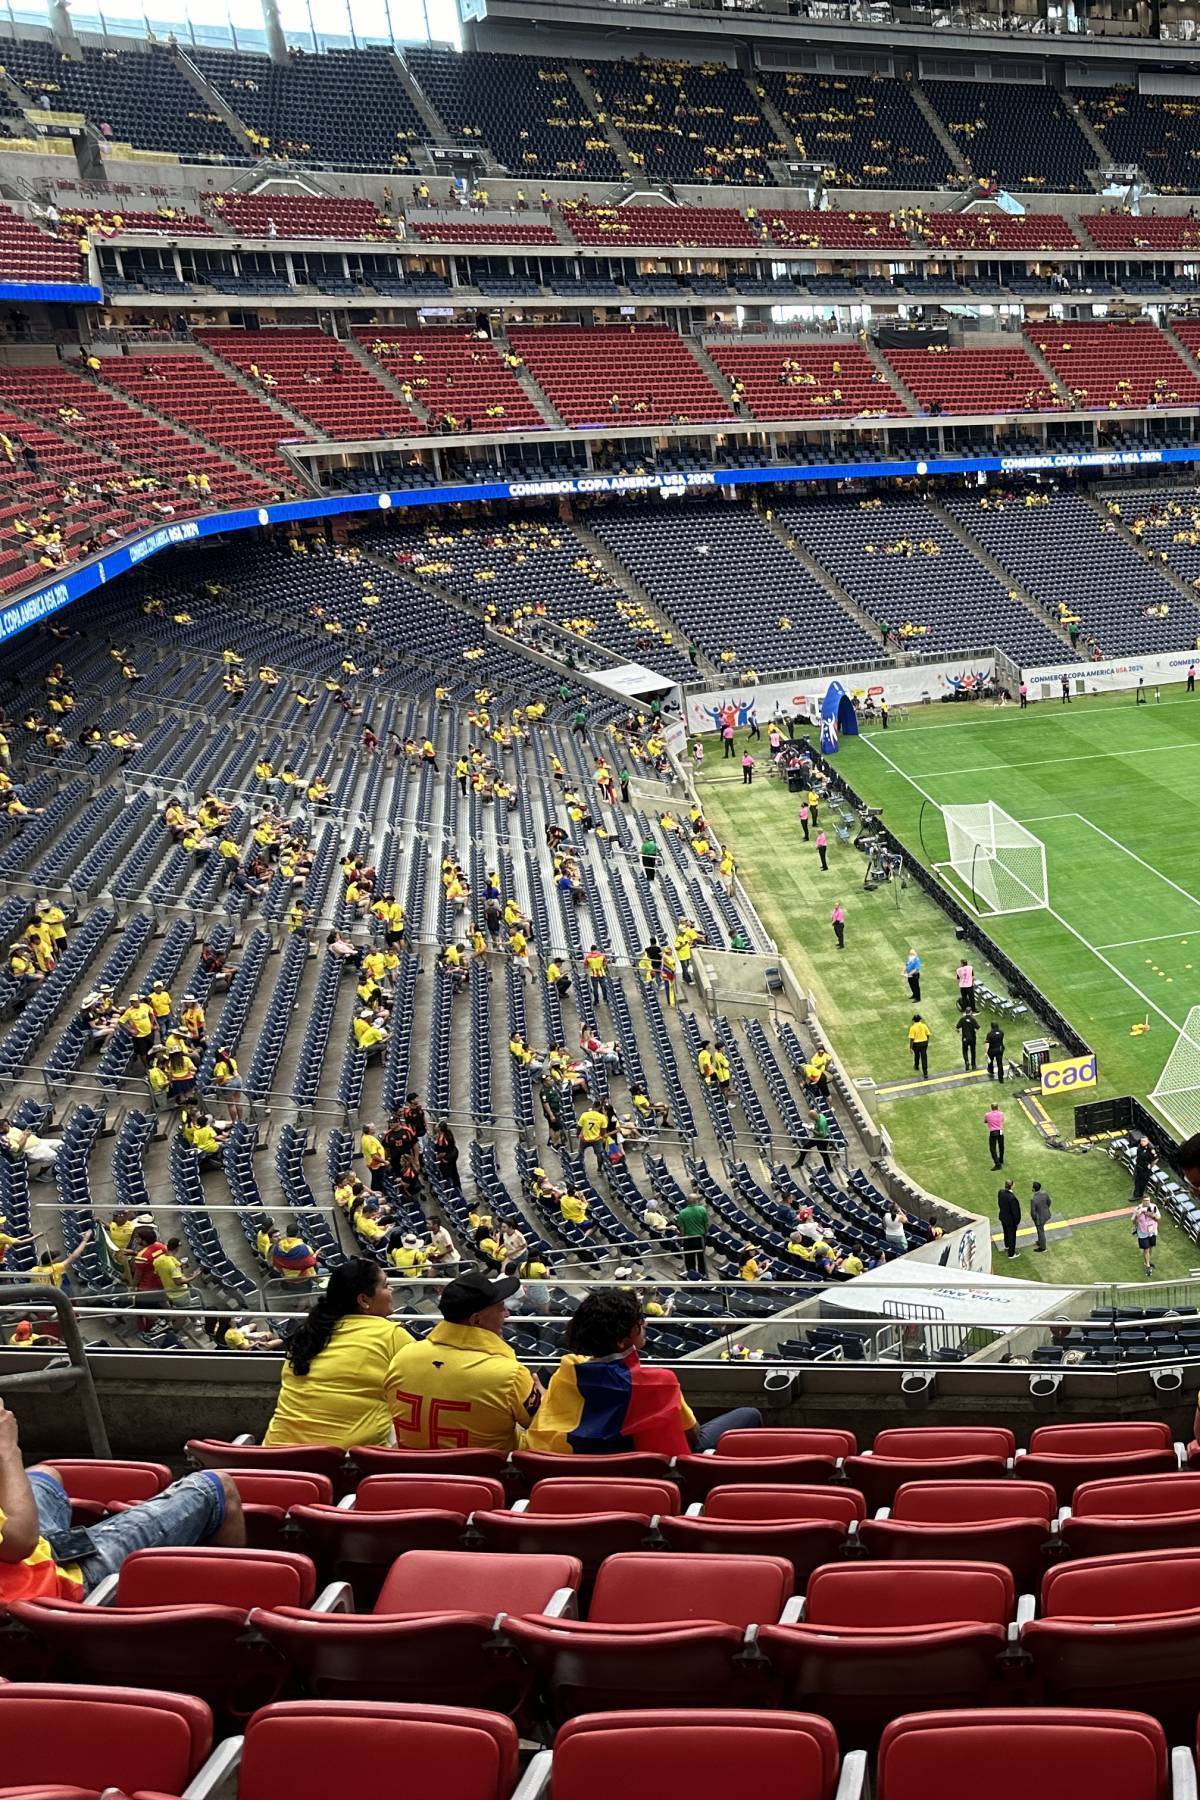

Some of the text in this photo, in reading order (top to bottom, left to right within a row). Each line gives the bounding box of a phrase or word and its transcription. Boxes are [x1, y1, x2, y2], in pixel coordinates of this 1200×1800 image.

[1001, 457, 1054, 468] CONMEBOL
[1055, 455, 1080, 466] COPA
[1080, 454, 1122, 465] AMERICA
[1122, 453, 1139, 462] USA
[509, 472, 715, 496] CONMEBOL COPA AMERICA USA 2024
[6, 606, 21, 634] COPA
[20, 596, 46, 626] AMERICA
[45, 590, 58, 614] USA
[1030, 674, 1065, 683] CONMEBO
[1067, 671, 1085, 680] COPA
[1086, 668, 1115, 678] AMERICA
[1044, 1058, 1096, 1088] cad
